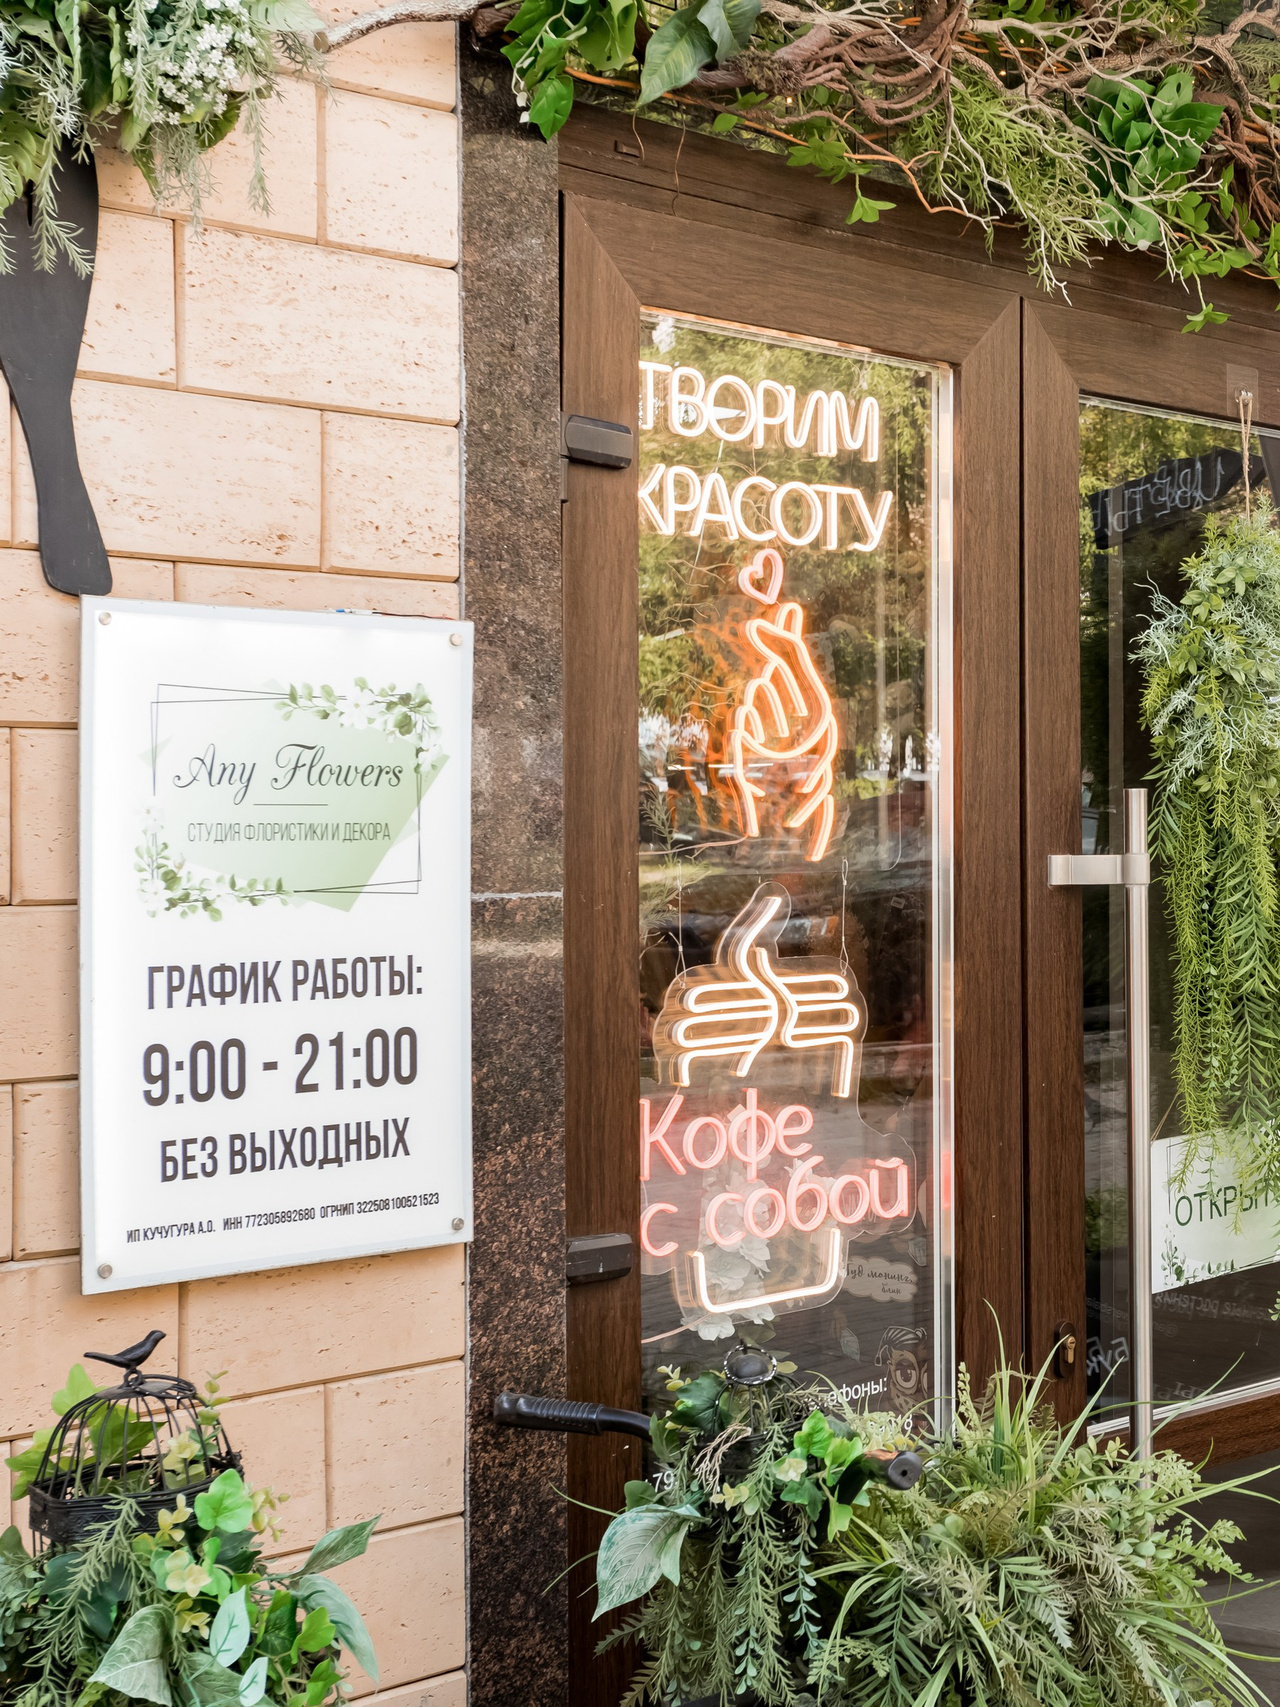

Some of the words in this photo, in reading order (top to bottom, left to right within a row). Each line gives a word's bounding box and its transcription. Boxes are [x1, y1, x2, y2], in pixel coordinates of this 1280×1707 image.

[639, 361, 880, 462] ТВОРИМ
[638, 464, 893, 551] КРАСОТУ
[173, 743, 256, 805] Any
[271, 743, 404, 790] Flowers
[188, 822, 240, 843] СТУДИЯ
[244, 822, 329, 842] ФЛОРИСТИКИ
[332, 822, 339, 841] И
[343, 822, 391, 843] ДЕКОРА
[147, 961, 282, 1009] ГРАФИК
[292, 955, 422, 1001] РАБОТЫ:
[143, 1038, 246, 1107] 9:00
[295, 1027, 417, 1093] 21:00
[161, 1136, 218, 1183] БЕЗ
[229, 1117, 410, 1176] ВЫХОДНЫХ
[640, 1088, 813, 1184] Кофе
[127, 1229, 140, 1243] ИП
[143, 1222, 195, 1241] КУЧУГУРА
[197, 1220, 216, 1235] А.О.
[223, 1216, 242, 1231] ИНН
[245, 1208, 315, 1228] 772305892680
[320, 1203, 354, 1219] ОГРНИП
[357, 1192, 440, 1214] 322508100521523
[640, 1203, 679, 1257] с
[705, 1155, 909, 1247] собой
